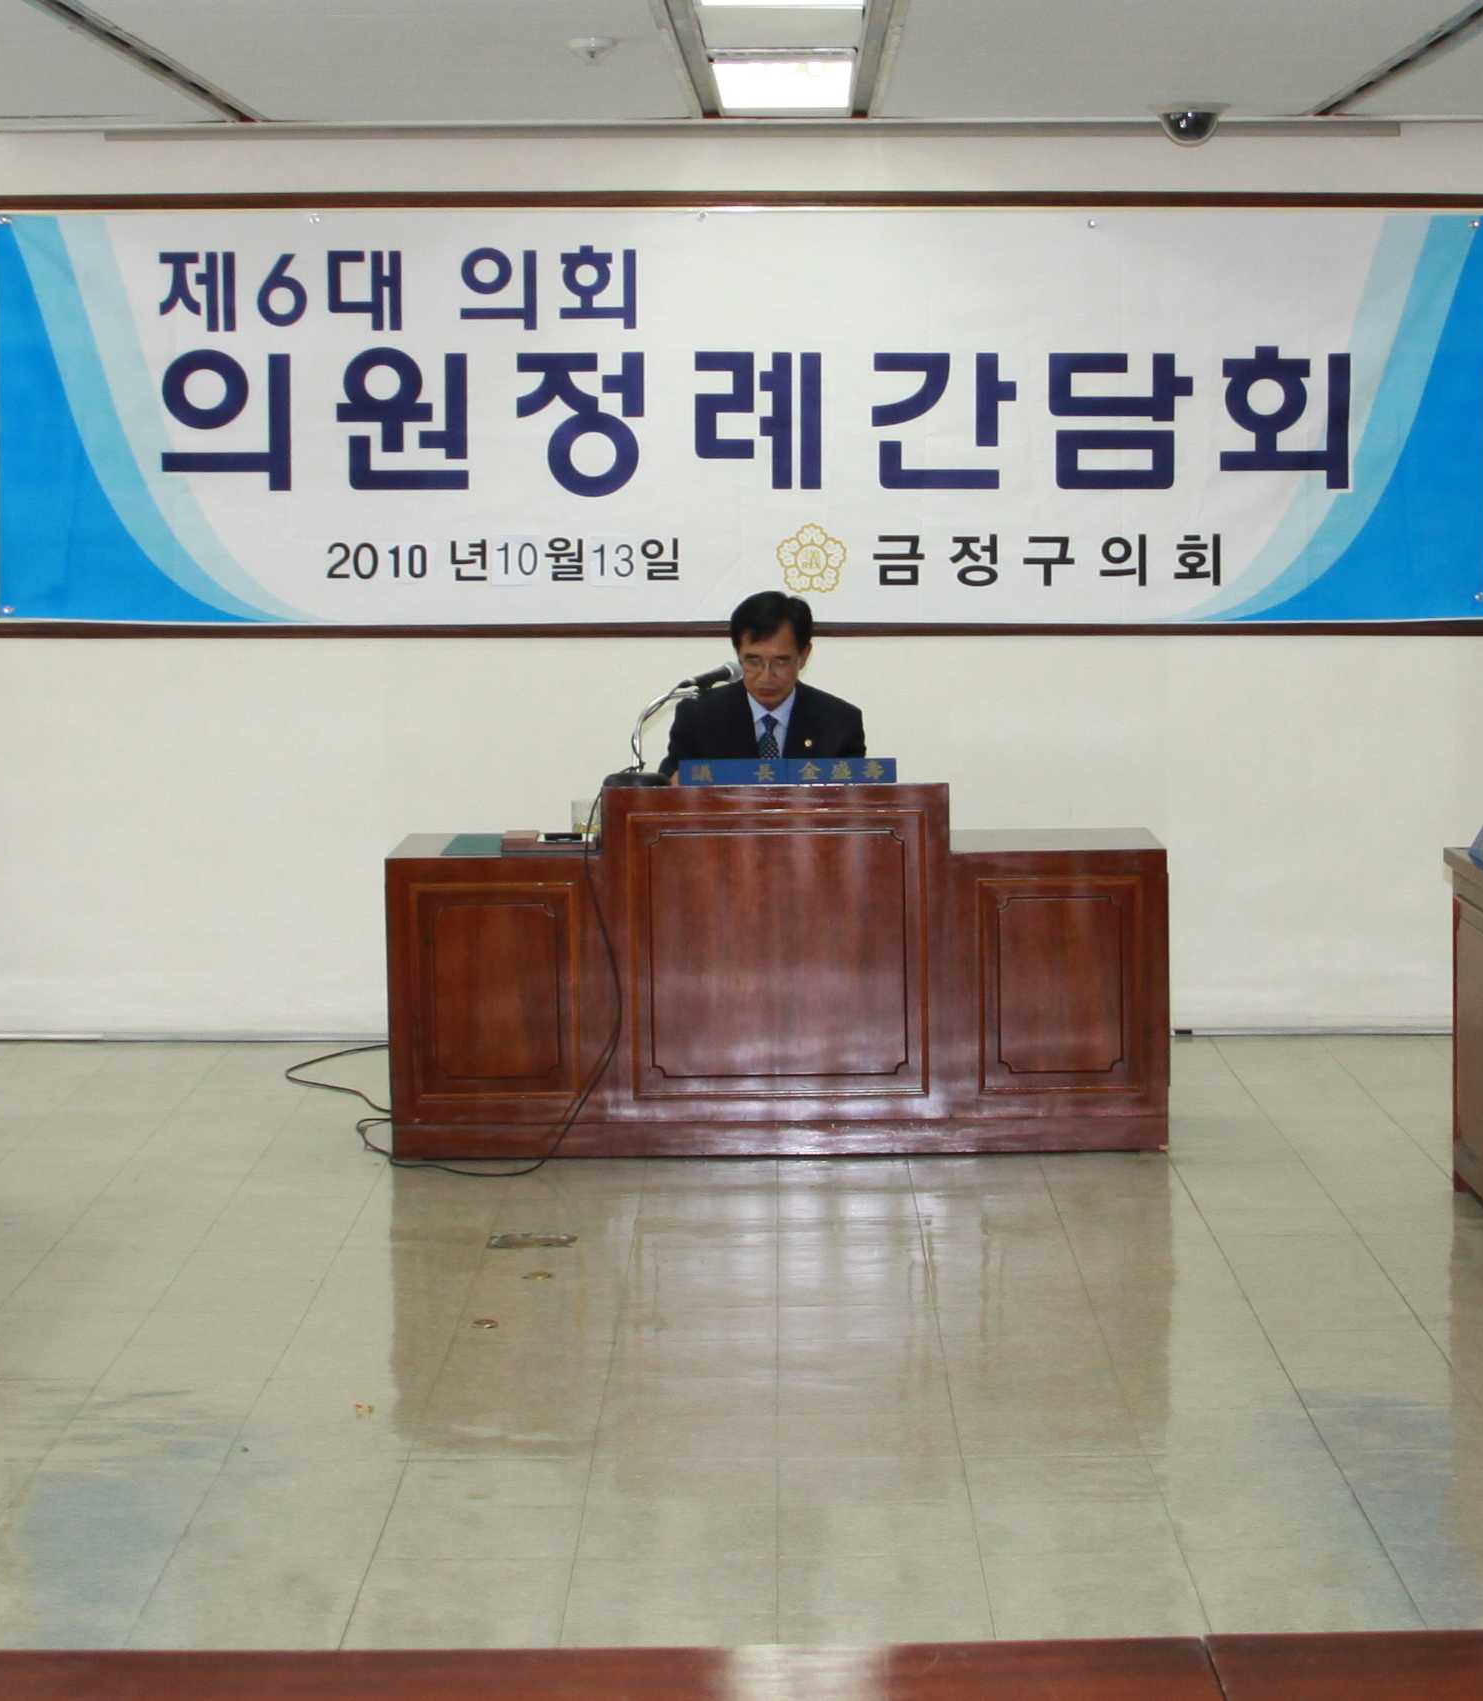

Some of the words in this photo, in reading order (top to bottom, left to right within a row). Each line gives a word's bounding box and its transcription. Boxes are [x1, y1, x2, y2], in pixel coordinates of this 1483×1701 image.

[159, 250, 403, 332] 제6대
[460, 245, 637, 331] 의회
[160, 345, 1352, 498] 의원정례간담회
[325, 542, 428, 580] 2010
[871, 533, 1222, 587] 금정구의회
